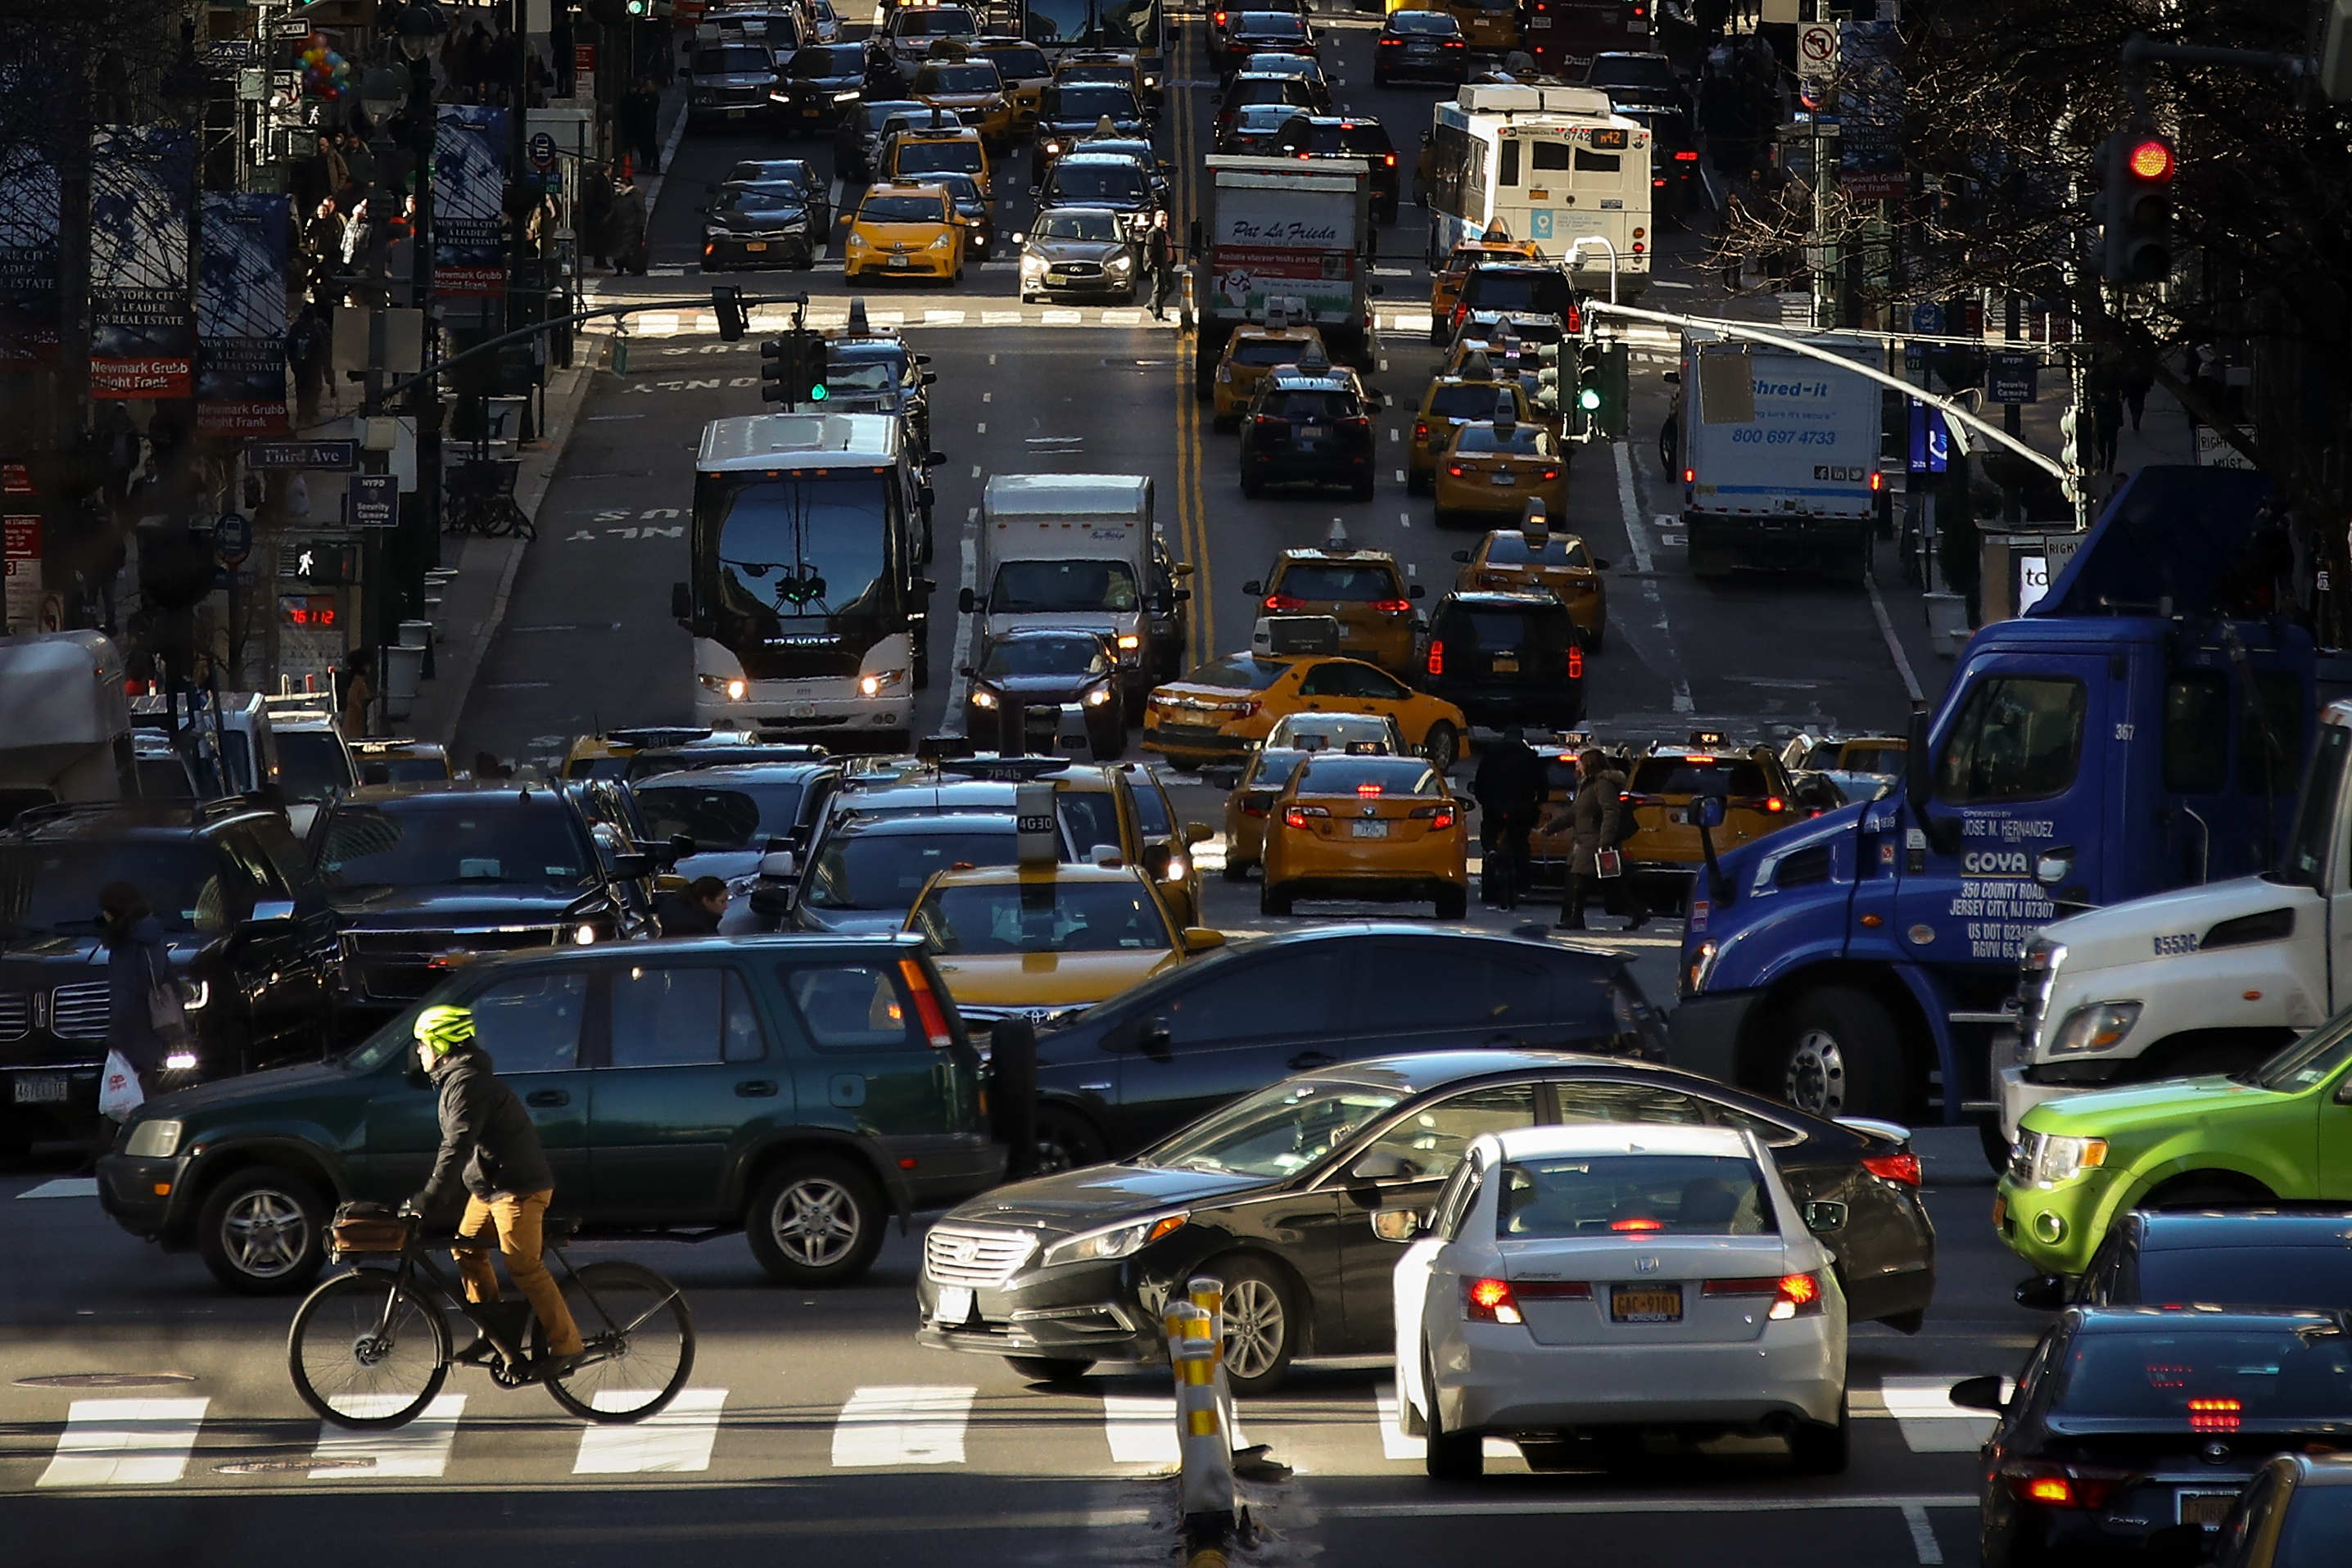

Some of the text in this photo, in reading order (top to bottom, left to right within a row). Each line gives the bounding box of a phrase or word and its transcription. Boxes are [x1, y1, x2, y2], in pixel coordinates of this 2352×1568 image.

[1564, 132, 1591, 142] 6742
[435, 219, 453, 228] NEW
[455, 219, 478, 228] YORK
[1232, 221, 1337, 241] Pat La Frieda
[453, 237, 470, 246] REAL
[471, 238, 500, 246] ESTATE
[434, 269, 503, 281] Newmark Grubb
[434, 280, 488, 291] Knight Frank
[120, 290, 152, 301] YORK
[111, 303, 167, 313] A LEADER
[96, 314, 184, 326] IN REAL ESTATE
[256, 341, 285, 350] CITY:
[215, 351, 223, 360] A
[91, 360, 188, 374] Newmark Grubb
[245, 362, 282, 372] ESTATE
[134, 376, 169, 388] Frank
[1997, 379, 2029, 390] Security
[1751, 380, 1828, 396] Shred-it
[1997, 388, 2028, 397] Camera
[197, 404, 286, 416] Newmark Grubb
[197, 415, 267, 430] Knight Frank
[1732, 428, 1836, 445] 800 697 4733
[265, 449, 339, 463] Third Ave
[362, 479, 386, 487] NYPD
[356, 502, 390, 513] Security
[357, 512, 390, 520] Camera
[7, 562, 15, 571] 3
[1962, 820, 2055, 838] JOSE M. HERNANDEZ
[1965, 852, 2028, 874] GOYA
[1961, 882, 2046, 901] 350 COUNTY ROAD
[1949, 899, 2056, 920] JERSEY CITY, NJ 07307
[1968, 923, 1982, 940] US
[1983, 924, 2002, 941] DOT
[1973, 941, 2001, 958] RGVW
[1626, 1313, 1667, 1322] MOREHEAD
[2108, 1516, 2151, 1527] CAMRY
